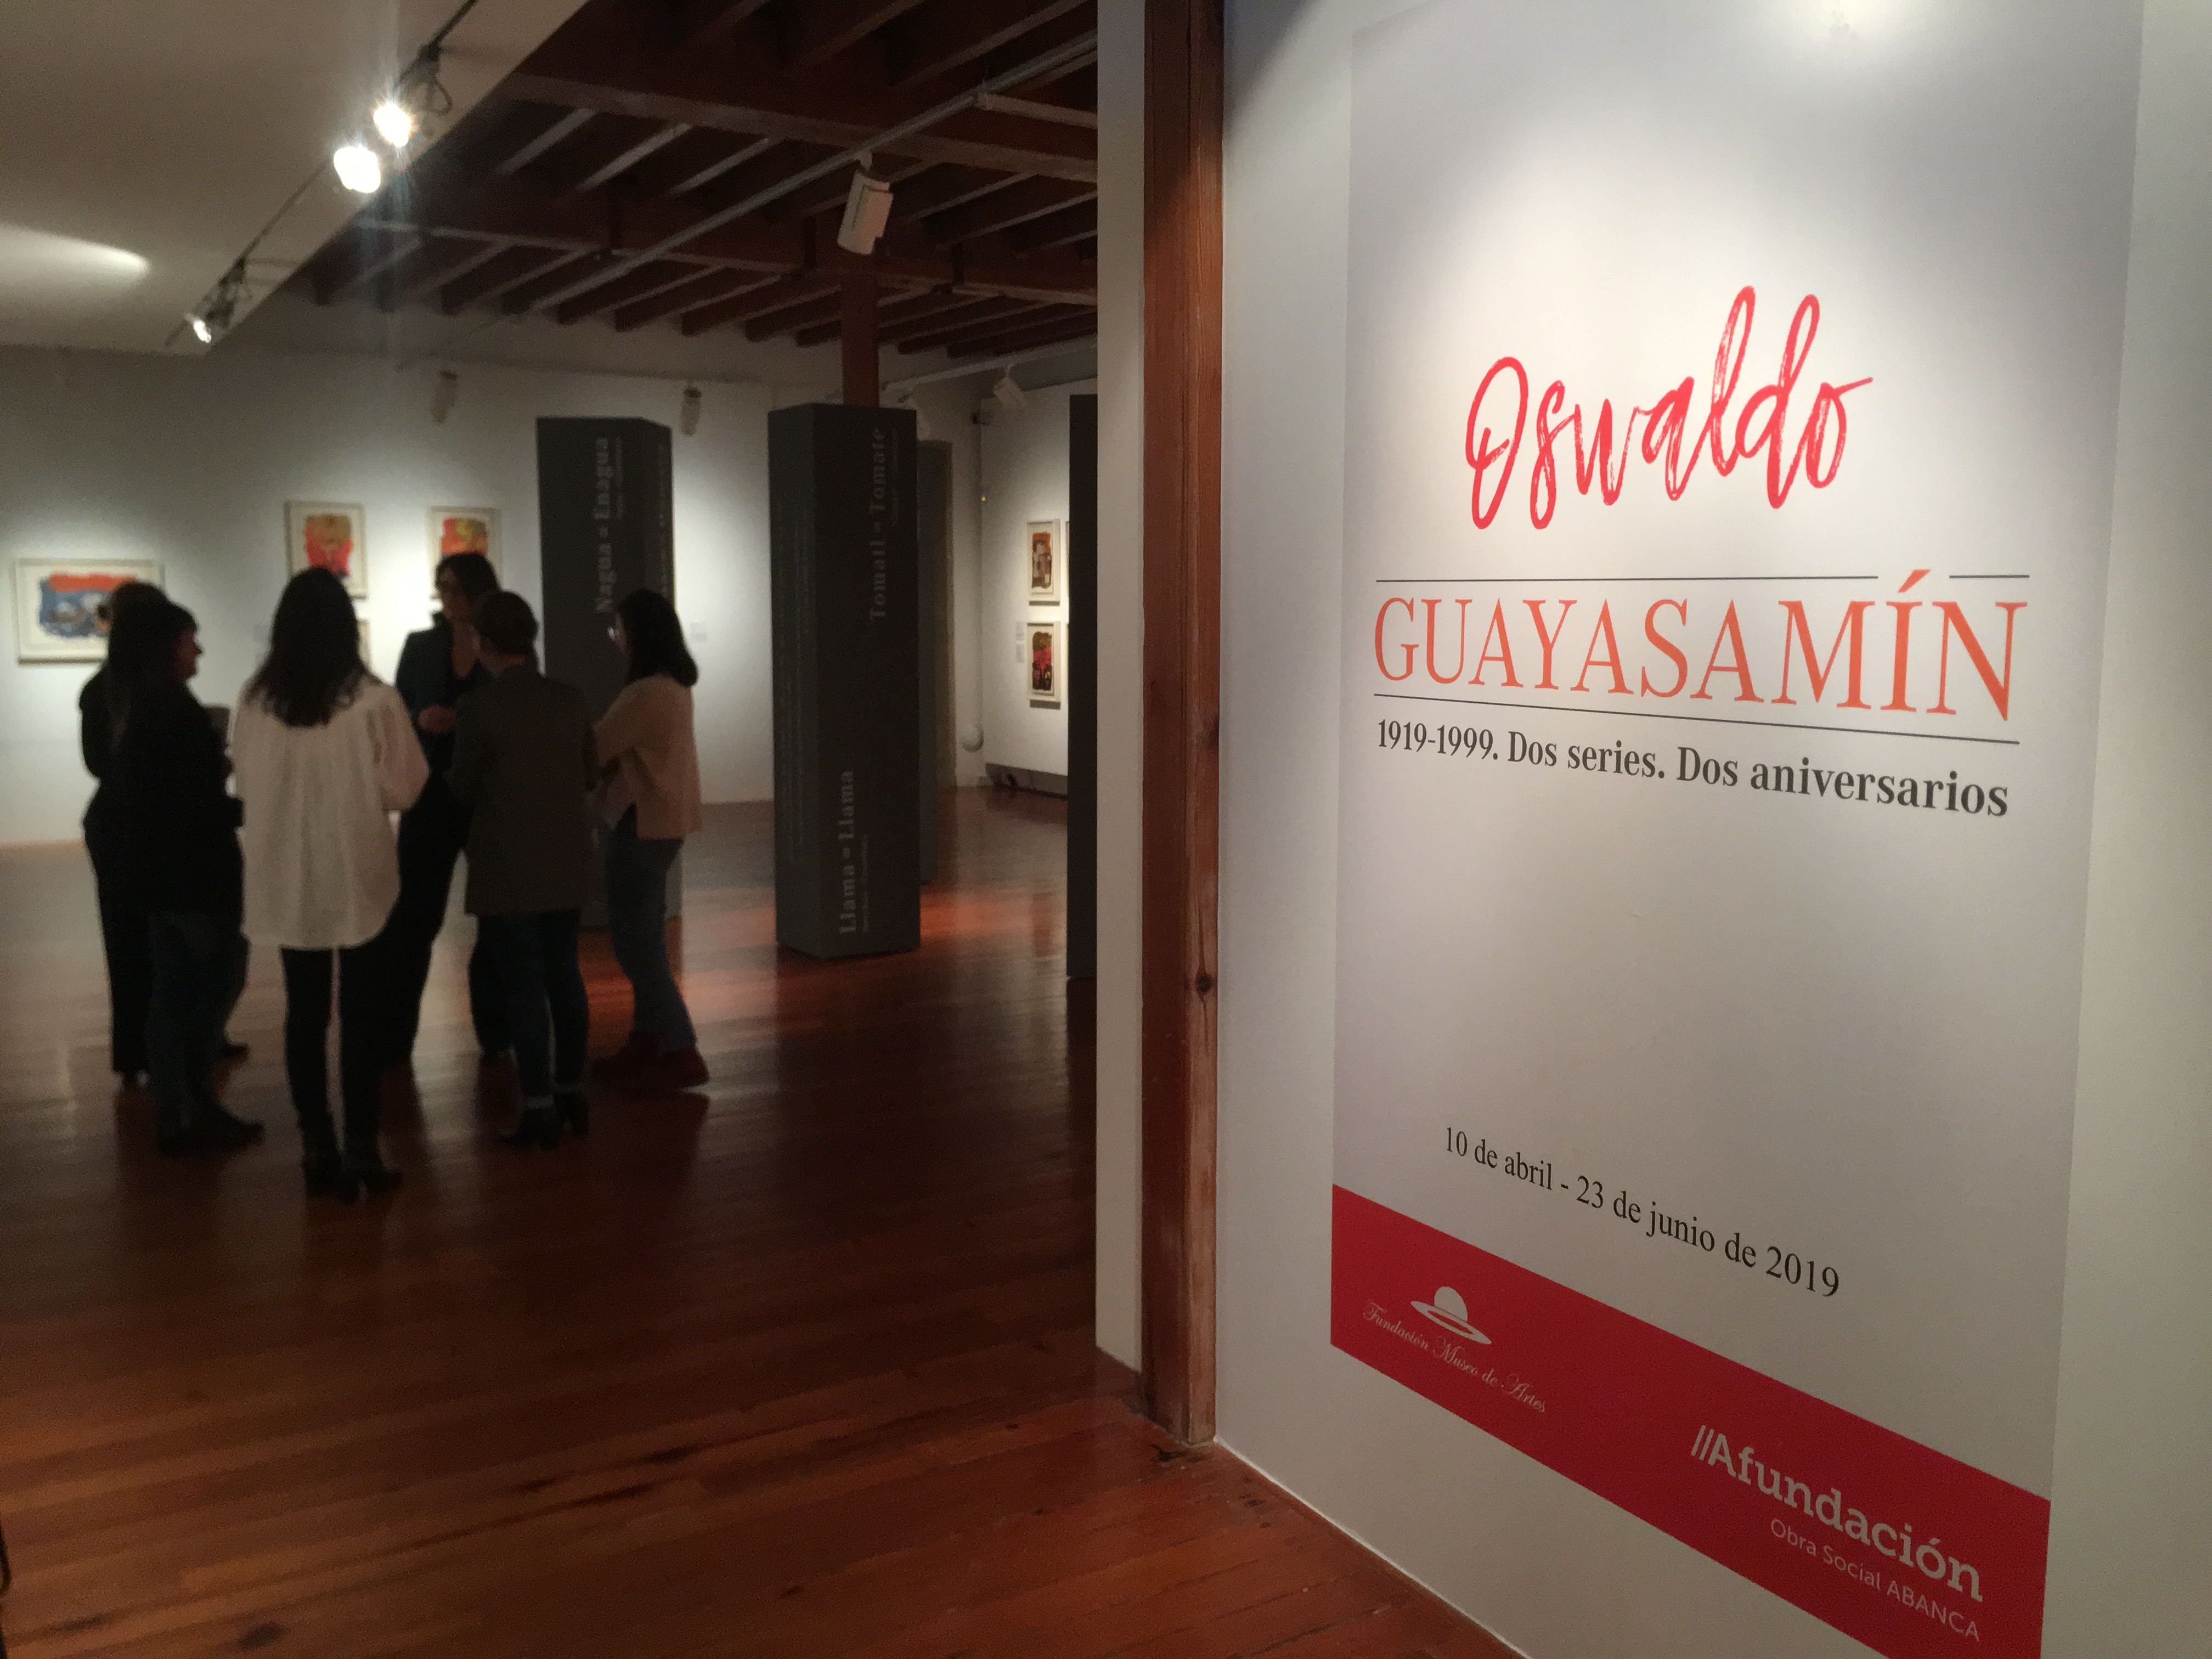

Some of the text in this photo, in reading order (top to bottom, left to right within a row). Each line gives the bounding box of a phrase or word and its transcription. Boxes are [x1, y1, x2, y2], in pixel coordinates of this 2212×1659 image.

[1464, 285, 1874, 531] Oswaldo
[1374, 568, 2028, 722] GUAYASAMÍN
[1378, 719, 2008, 817] 1919-1999. Dos series. Dos aniversarios
[1446, 1127, 1468, 1156] 10
[1474, 1138, 1498, 1169] de
[1504, 1152, 1553, 1191] abril
[1576, 1175, 1604, 1209] 23
[1613, 1190, 1641, 1224] de
[1646, 1201, 1716, 1252] junio
[1724, 1232, 1757, 1268] de
[1765, 1246, 1839, 1297] 2019
[1363, 1301, 1545, 1413] Fundación Museo de Artes
[1770, 1518, 1980, 1642] Obra Social ABANCA
